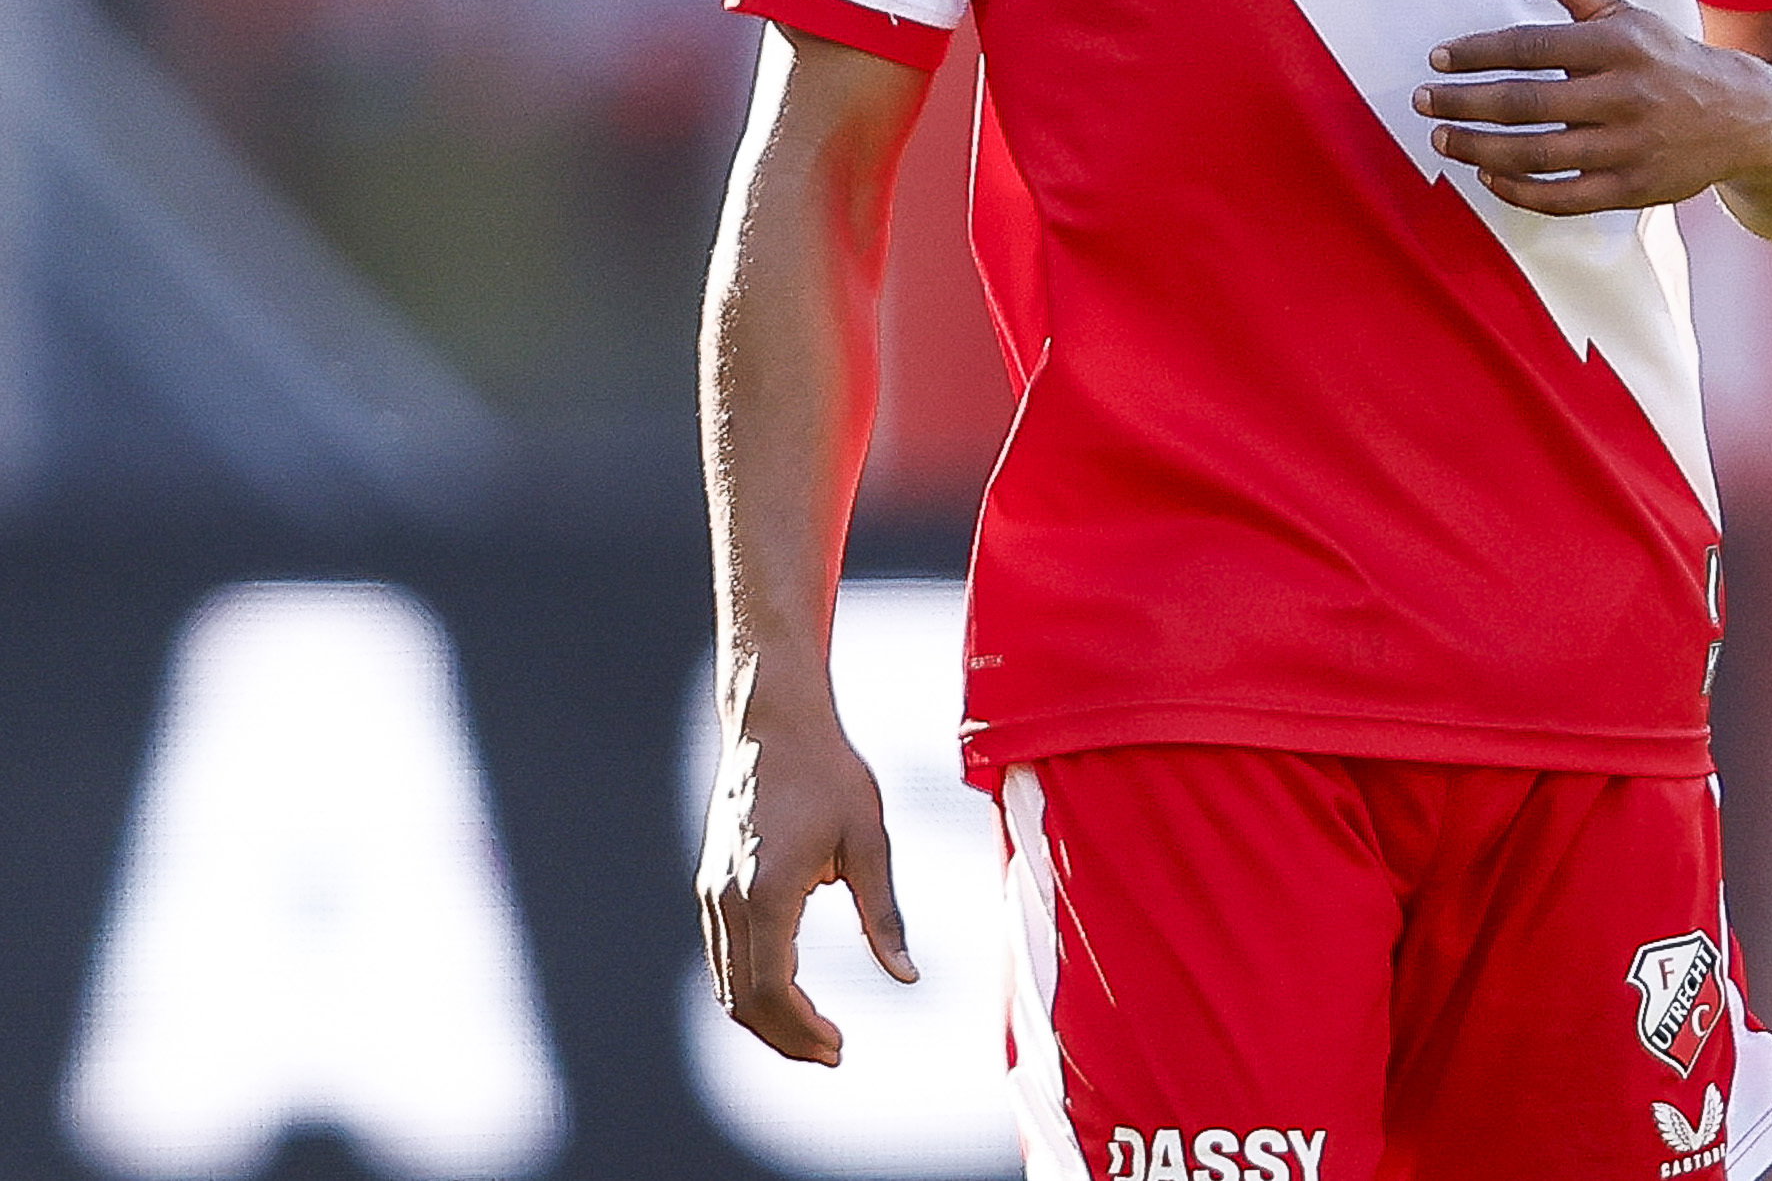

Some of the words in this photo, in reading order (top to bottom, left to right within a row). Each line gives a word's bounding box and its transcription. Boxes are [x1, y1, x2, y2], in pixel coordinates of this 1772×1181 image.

[1658, 957, 1675, 991] F
[1651, 944, 1715, 1051] UTRECHT
[1691, 1004, 1711, 1039] C
[1107, 1126, 1327, 1181] DASSY
